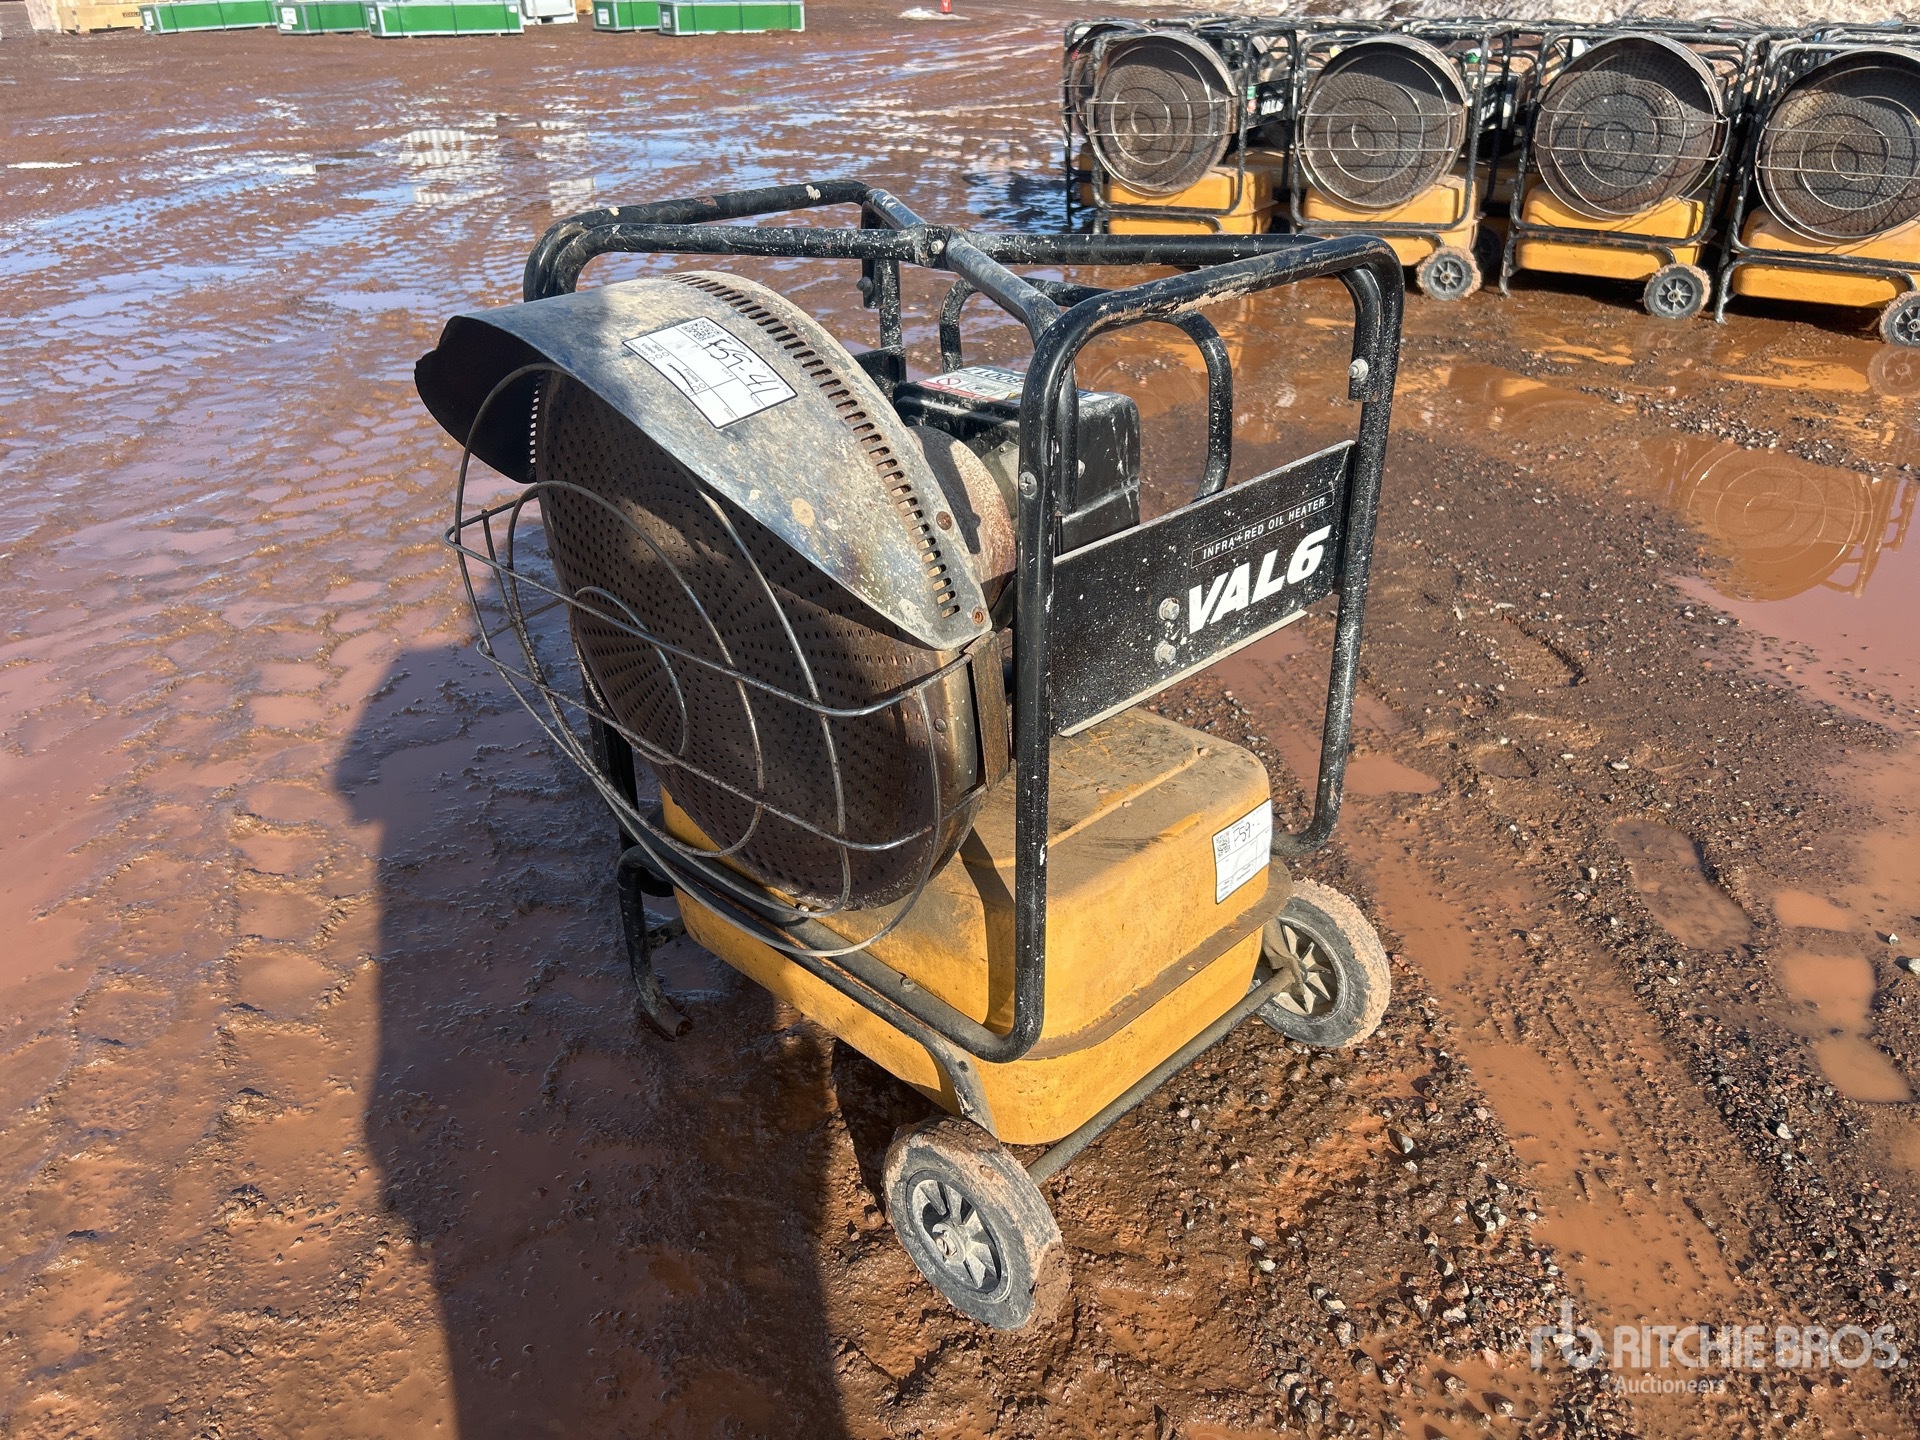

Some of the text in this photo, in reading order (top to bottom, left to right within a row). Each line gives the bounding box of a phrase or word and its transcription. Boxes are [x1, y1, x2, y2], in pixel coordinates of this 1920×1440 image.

[1268, 515, 1285, 530] OIL
[1288, 497, 1326, 521] HEATER
[1188, 524, 1332, 634] VAL6
